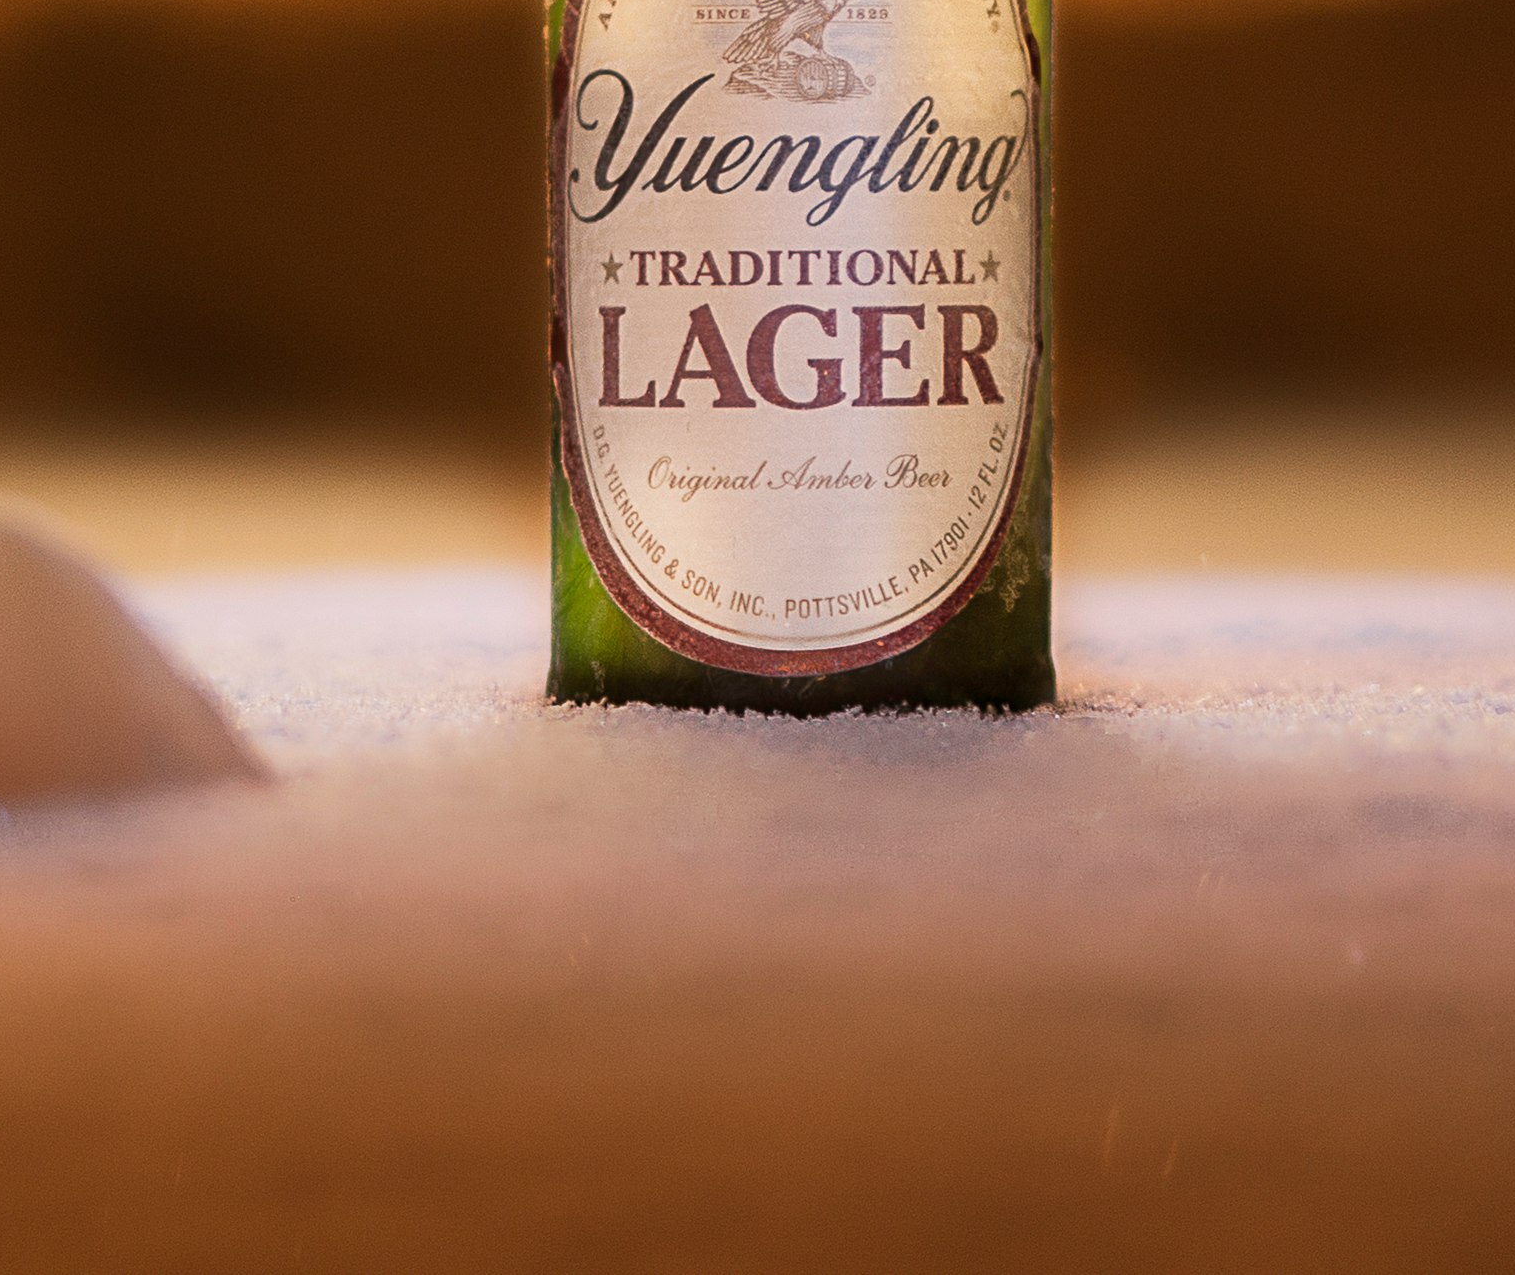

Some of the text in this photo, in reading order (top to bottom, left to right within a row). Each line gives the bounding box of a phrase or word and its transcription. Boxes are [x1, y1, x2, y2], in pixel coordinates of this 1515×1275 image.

[695, 8, 751, 21] SINCE
[567, 68, 1030, 227] Yuengling
[629, 249, 975, 287] TRADITIONAL
[598, 302, 1005, 410] LAGER
[592, 423, 611, 464] D.G.
[647, 453, 953, 503] Original Amber Beer
[977, 458, 1000, 487] FL.
[604, 463, 666, 565] YUENGLING
[968, 485, 987, 510] 12
[930, 516, 971, 566] 17901
[663, 558, 680, 581] &
[681, 569, 723, 608] SON,
[908, 558, 935, 585] PA
[729, 590, 776, 621] INC.,
[785, 576, 911, 620] POTTSVILLE,
